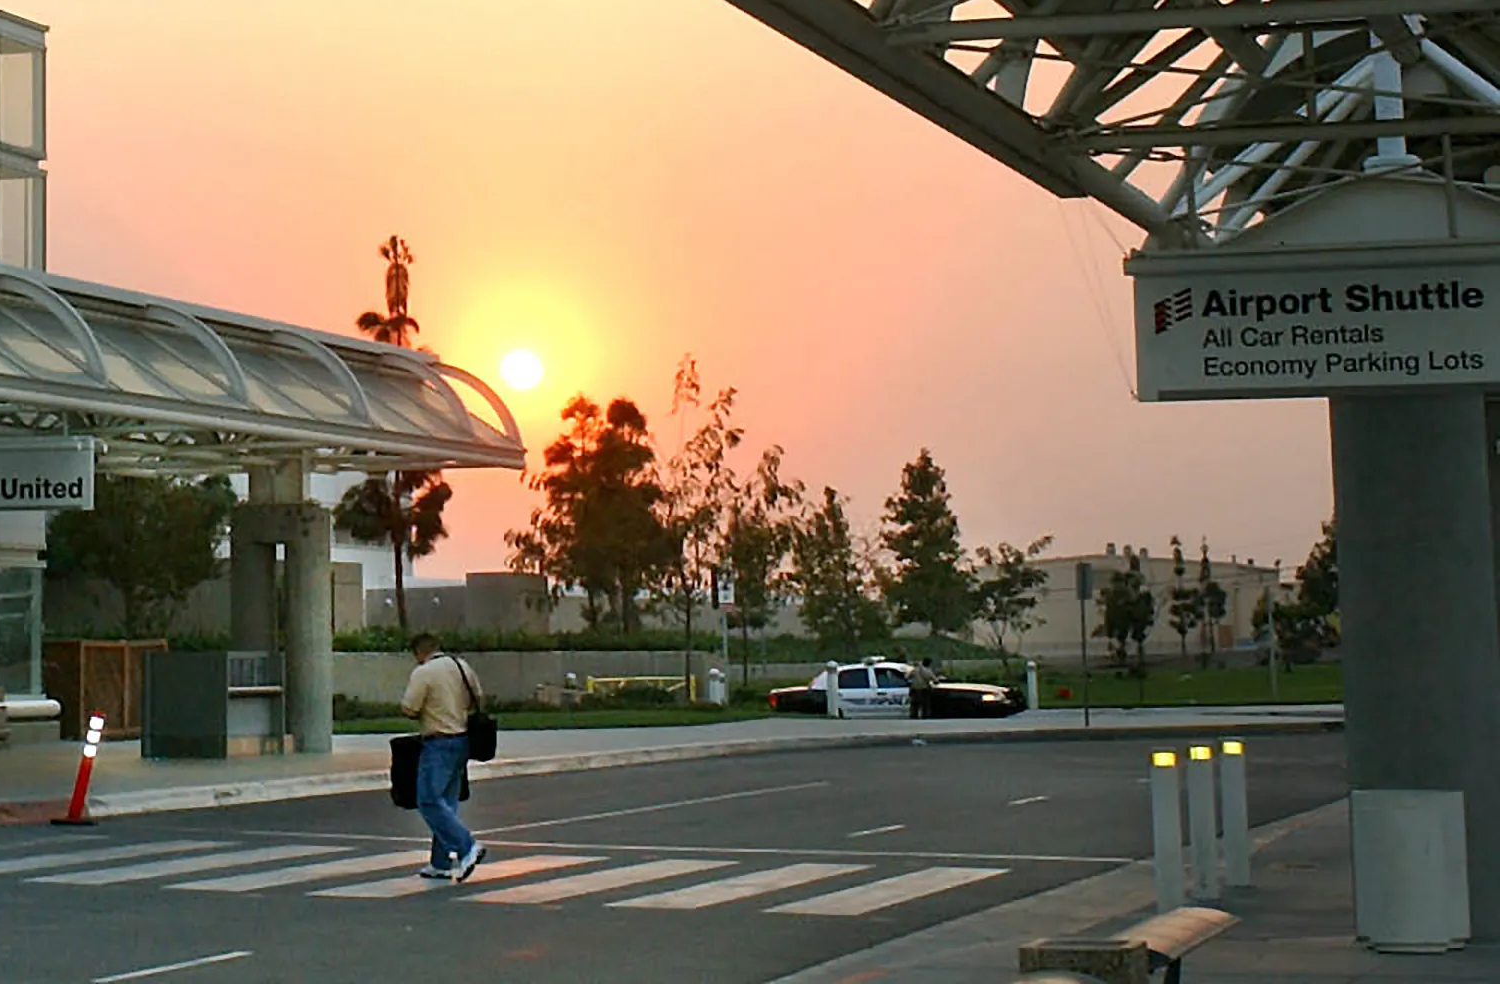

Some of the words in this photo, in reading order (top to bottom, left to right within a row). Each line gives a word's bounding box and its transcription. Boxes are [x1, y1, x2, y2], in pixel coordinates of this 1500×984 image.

[1202, 287, 1332, 321] Airport
[1345, 281, 1485, 313] Shuttle
[1202, 327, 1233, 349] All
[1240, 326, 1284, 348] Car
[1291, 324, 1384, 347] Rentals
[1203, 355, 1317, 379] Economy
[1326, 351, 1420, 375] Parking
[1428, 350, 1485, 371] Lots
[0, 476, 84, 500] United
